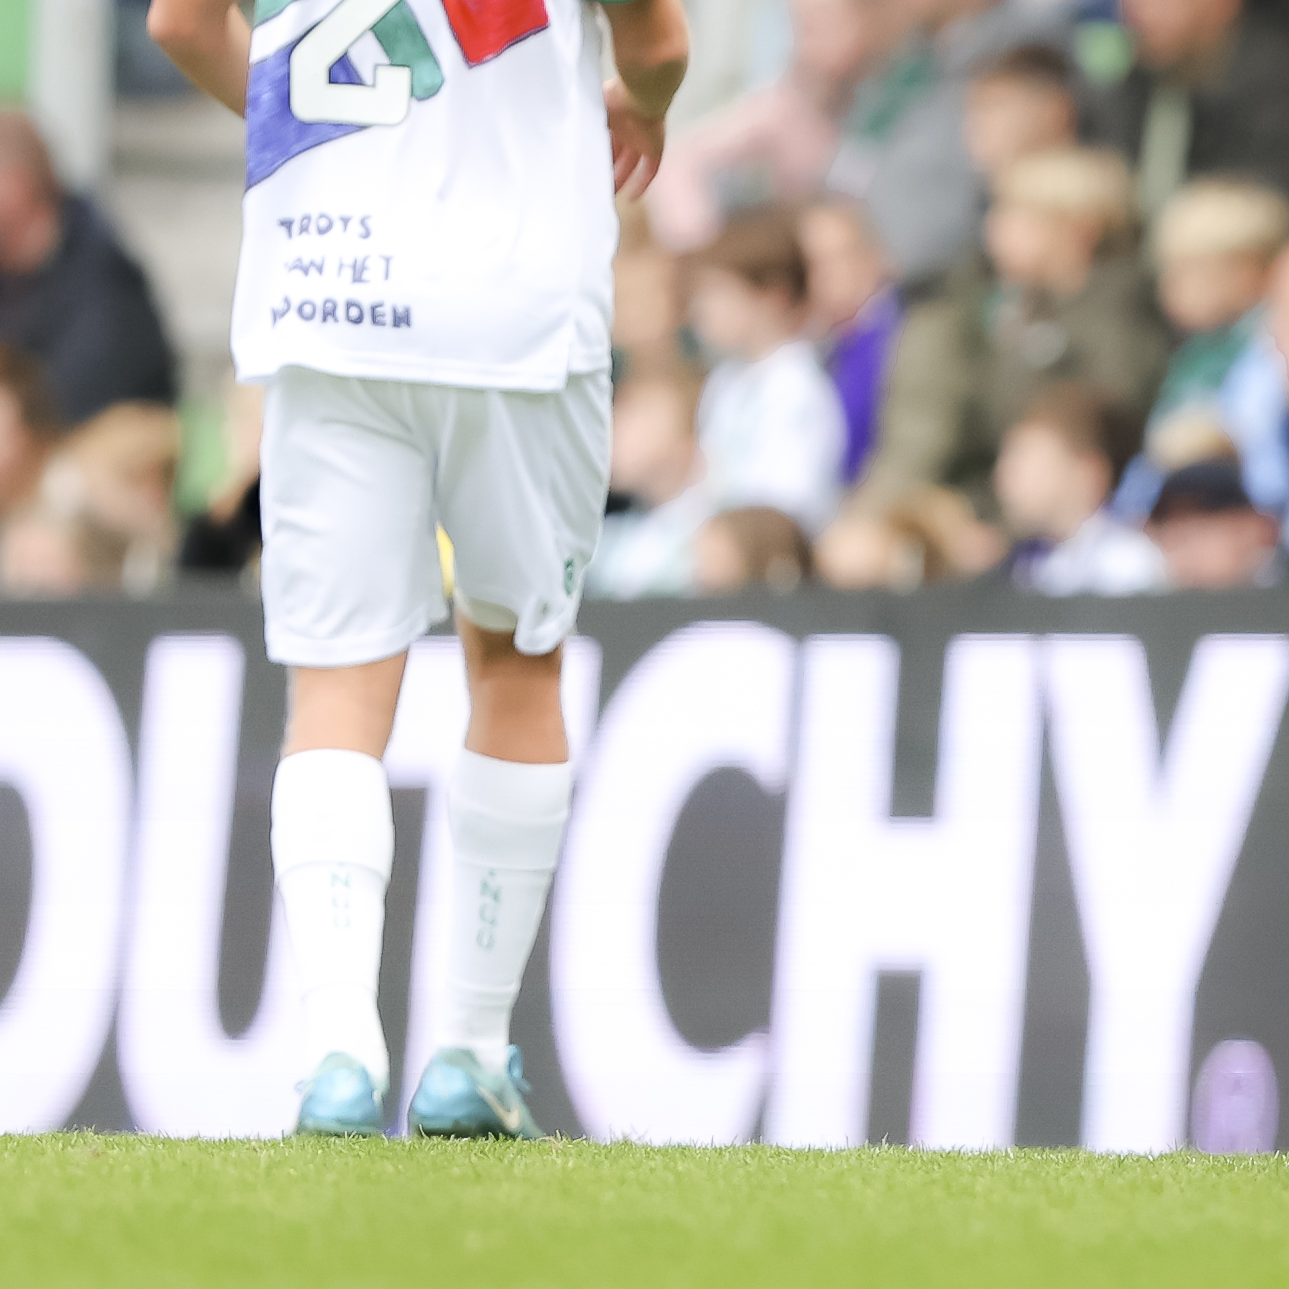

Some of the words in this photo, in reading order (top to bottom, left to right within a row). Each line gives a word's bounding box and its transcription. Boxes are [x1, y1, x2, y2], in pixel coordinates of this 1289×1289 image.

[277, 213, 372, 240] TROTS
[285, 255, 325, 277] AN
[337, 254, 394, 284] HET
